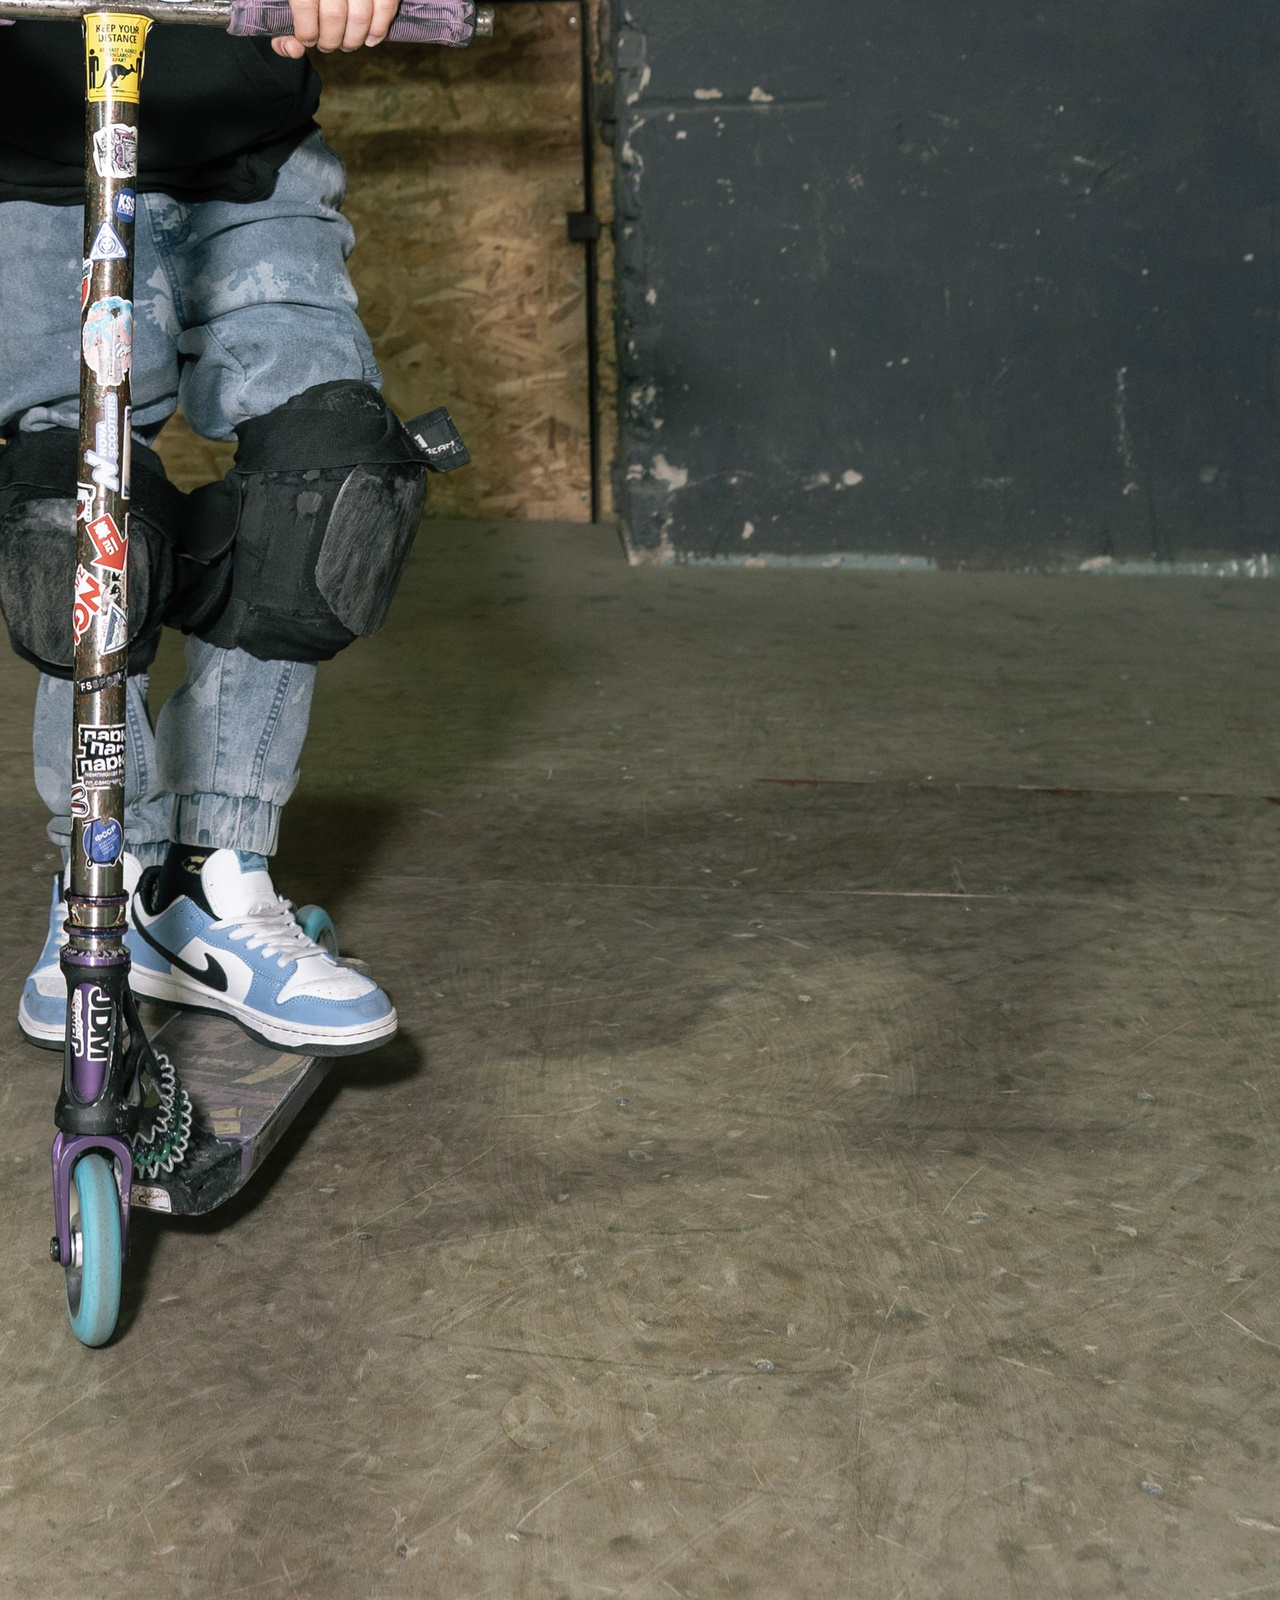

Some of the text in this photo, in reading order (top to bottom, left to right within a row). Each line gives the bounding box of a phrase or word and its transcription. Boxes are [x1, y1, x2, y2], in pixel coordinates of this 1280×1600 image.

[95, 24, 140, 35] KEEP YOUR
[98, 34, 137, 44] DISTANCE
[117, 193, 136, 213] KSS
[107, 394, 117, 459] SCOOTERS
[98, 423, 108, 458] NOVA
[81, 754, 125, 774] парк
[94, 824, 116, 842] ФССР
[90, 987, 111, 1060] JDM
